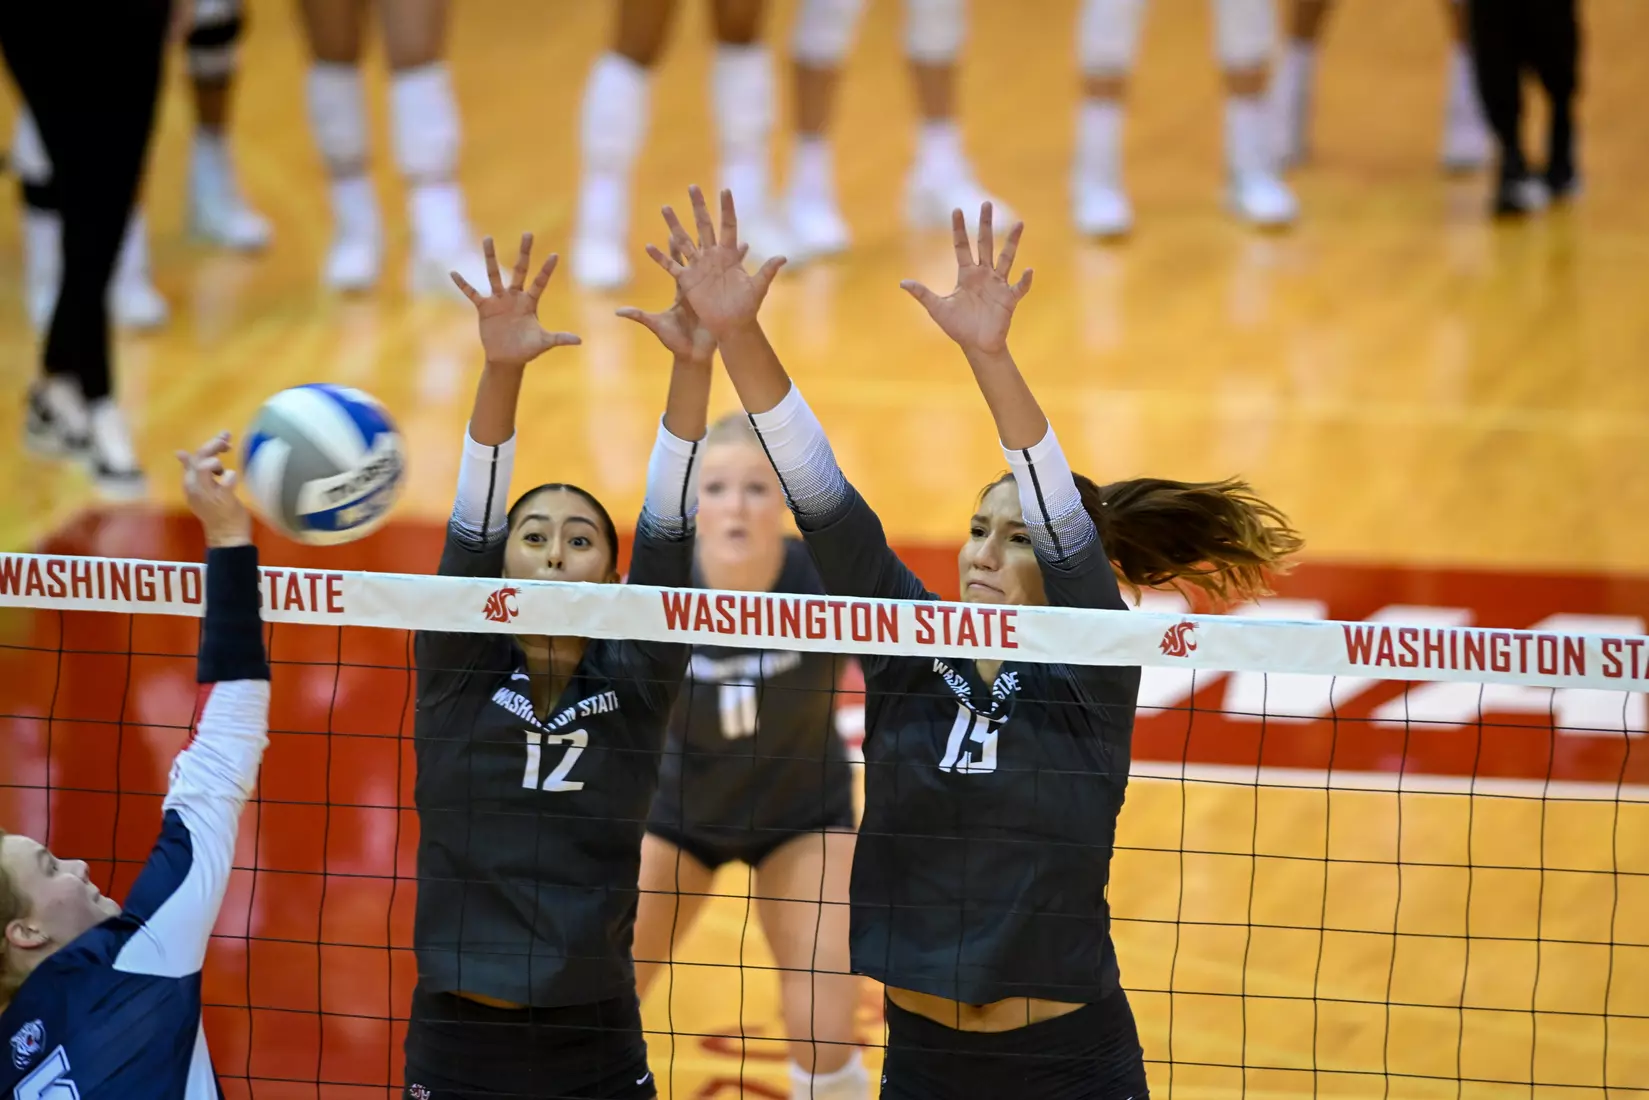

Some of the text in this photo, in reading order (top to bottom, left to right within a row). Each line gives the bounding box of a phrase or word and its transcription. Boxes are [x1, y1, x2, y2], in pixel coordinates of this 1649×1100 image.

[0, 556, 345, 614] WASHINGTO TATE
[660, 590, 1019, 649] WASHINGTON STATE
[1343, 623, 1649, 680] WASHINGTON ST
[521, 728, 589, 793] 12
[938, 700, 1009, 775] 15
